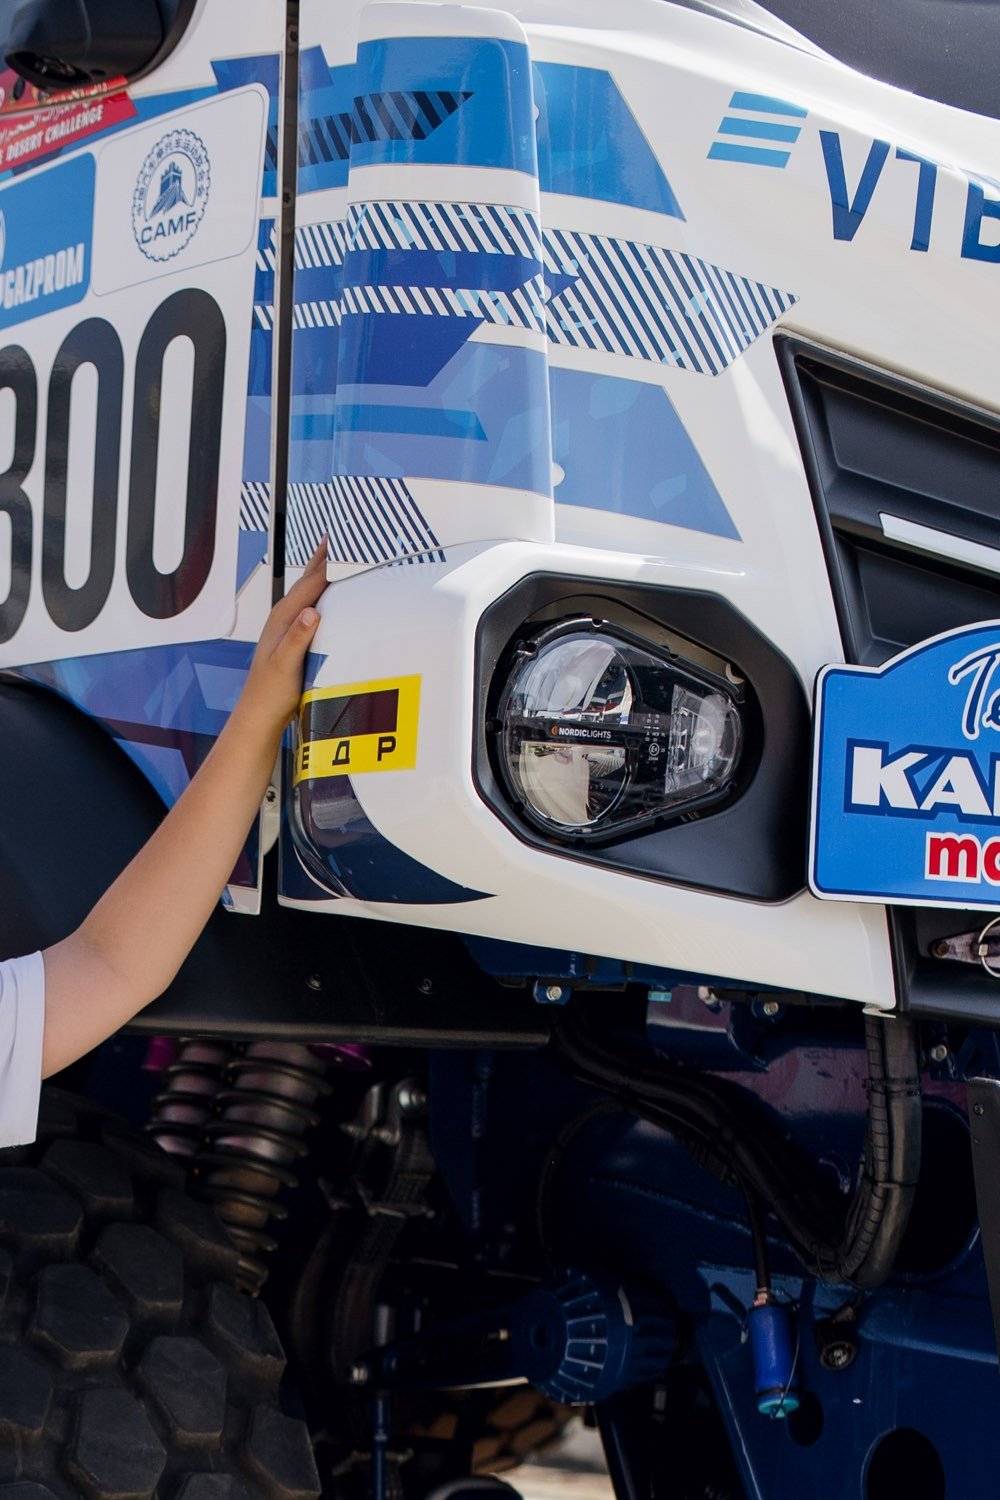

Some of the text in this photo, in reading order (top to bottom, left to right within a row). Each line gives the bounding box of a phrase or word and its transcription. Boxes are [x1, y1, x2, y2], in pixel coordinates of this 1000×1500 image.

[44, 104, 104, 144] CHALLENGE
[819, 130, 1000, 263] VTB
[141, 211, 197, 245] CAMF
[3, 242, 85, 310] GAZPROM
[559, 727, 612, 739] NORDICLIGHTS
[850, 745, 1000, 818] KA
